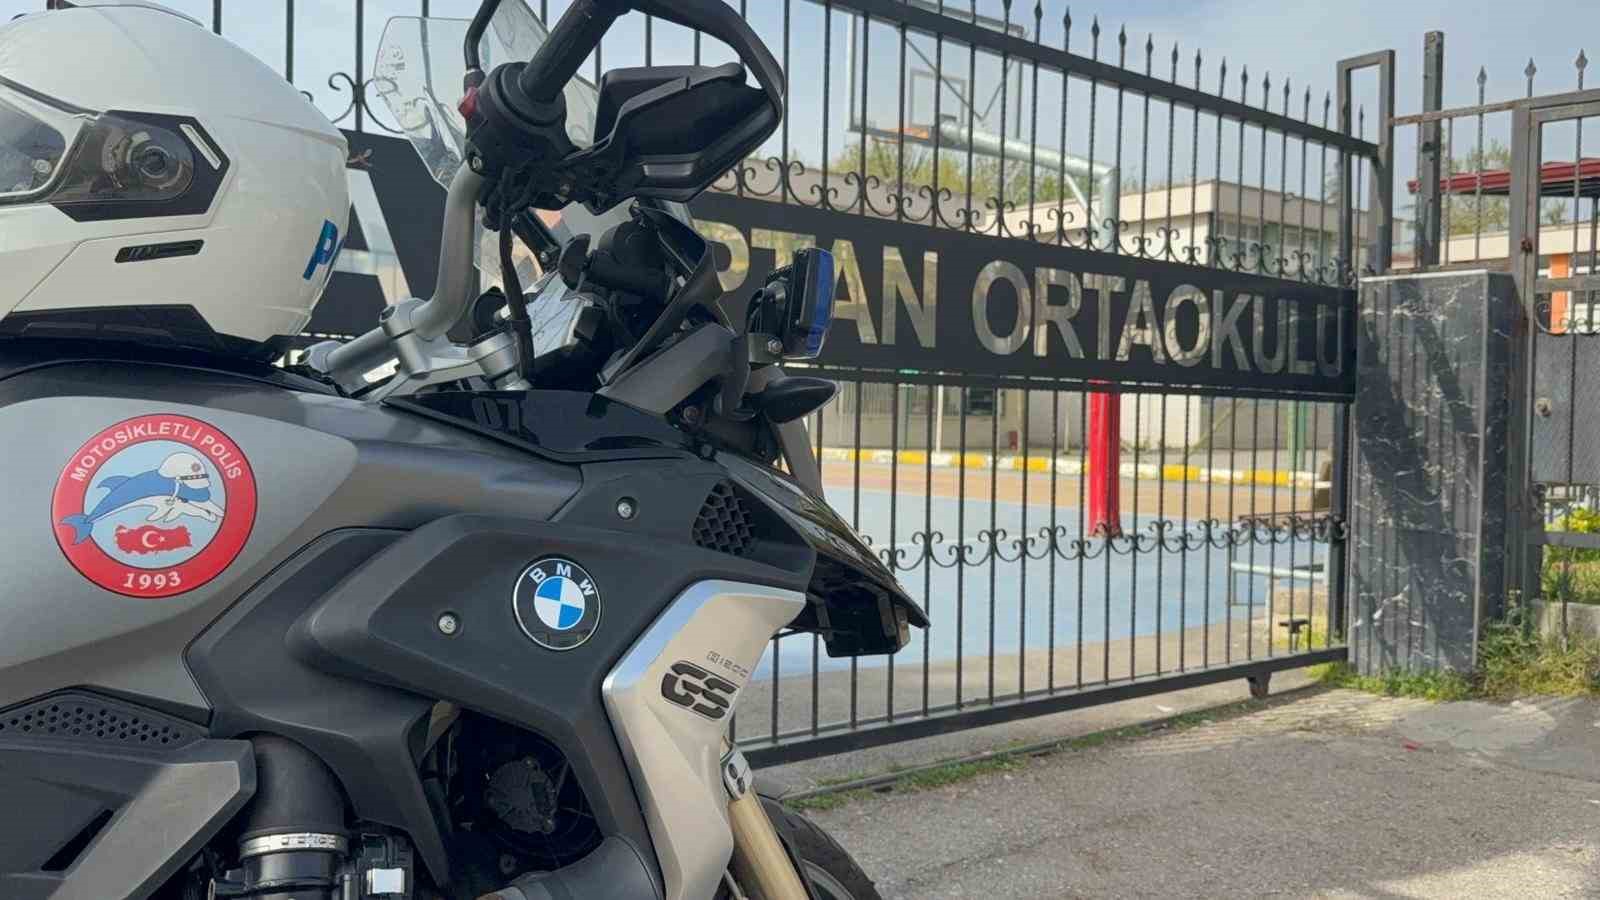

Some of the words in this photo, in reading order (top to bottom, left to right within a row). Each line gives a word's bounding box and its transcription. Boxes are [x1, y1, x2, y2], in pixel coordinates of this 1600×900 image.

[303, 219, 343, 282] P
[972, 259, 1343, 377] ORTAOKULU
[70, 421, 203, 482] MOTOSİKLETLİ
[200, 434, 242, 480] POLİS
[123, 571, 182, 590] 1993
[528, 562, 595, 597] BMW
[661, 660, 741, 720] GS
